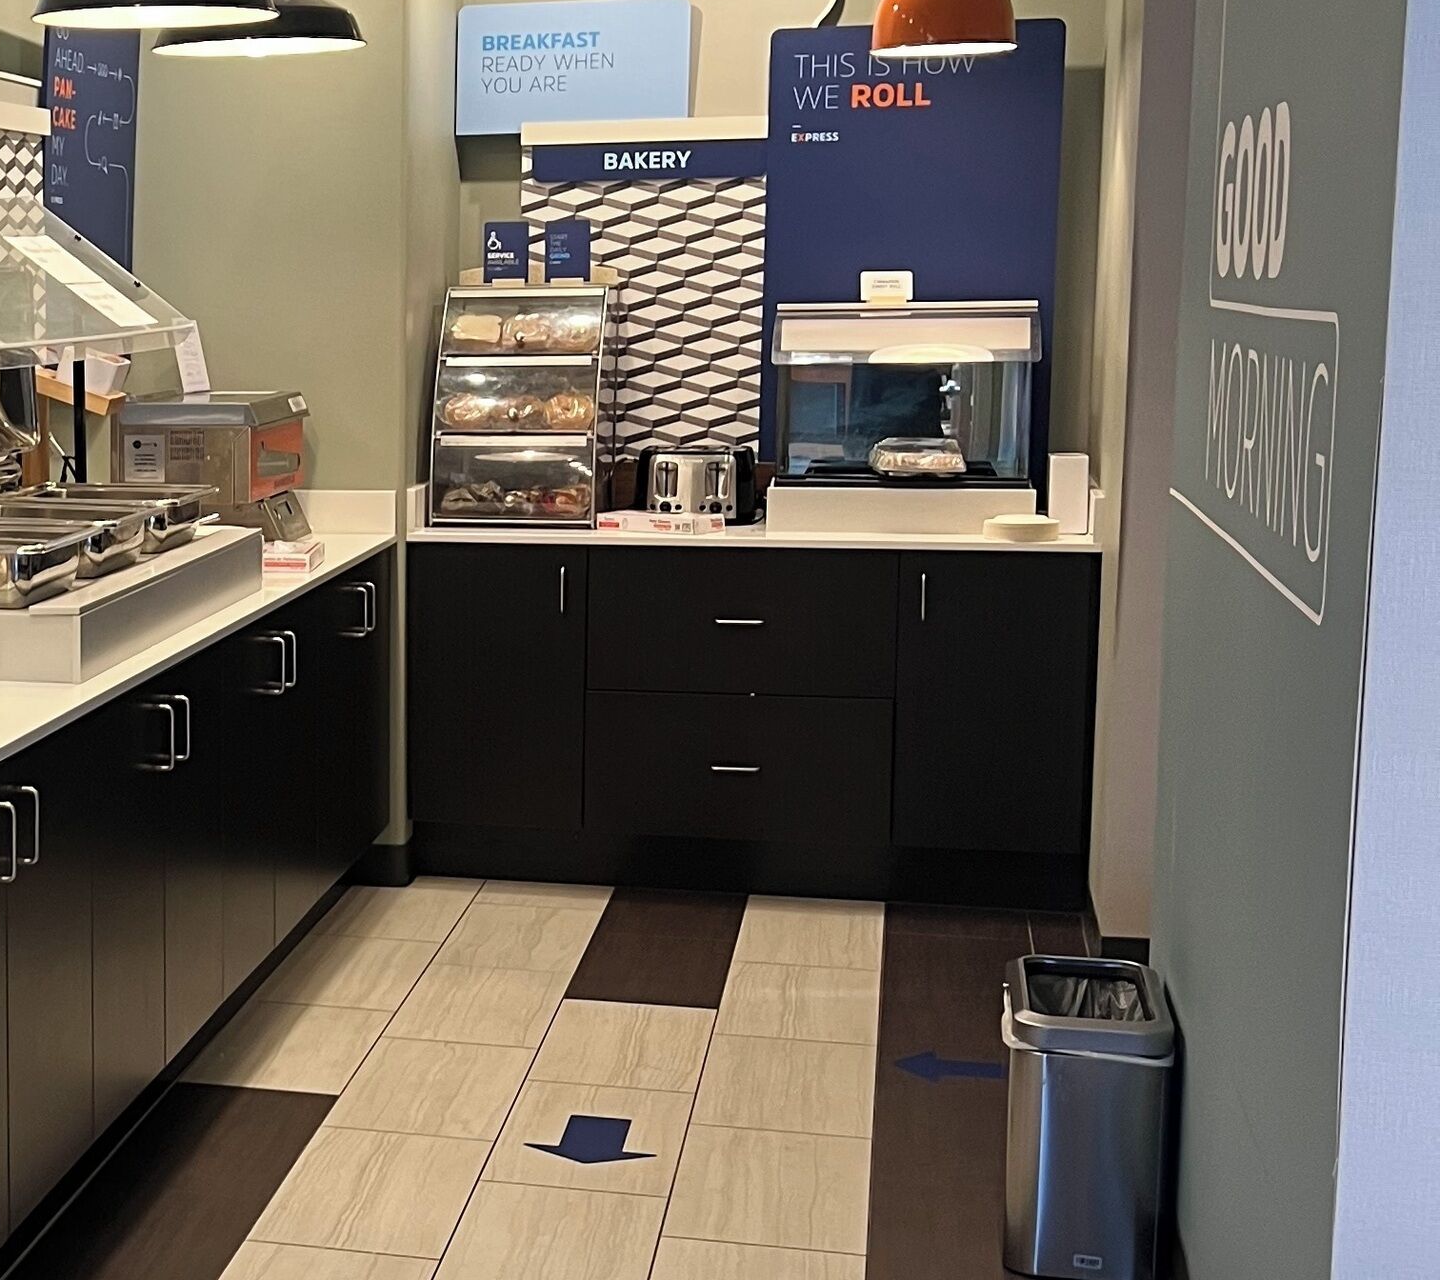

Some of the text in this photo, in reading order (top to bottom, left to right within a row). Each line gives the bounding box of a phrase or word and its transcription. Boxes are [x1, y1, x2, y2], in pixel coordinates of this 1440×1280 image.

[482, 31, 600, 51] BREAKFAST
[481, 52, 614, 73] READY WHEN
[794, 52, 976, 79] THIS IS HOW
[53, 75, 77, 99] PAN-
[481, 75, 567, 94] YOU ARE
[793, 82, 931, 110] WE ROLL
[52, 105, 77, 130] CAKE
[51, 135, 65, 156] MY
[791, 131, 839, 143] EXPRESS
[604, 150, 691, 170] BAKERY
[1216, 101, 1291, 280] GOOD
[1206, 338, 1329, 562] MORNING
